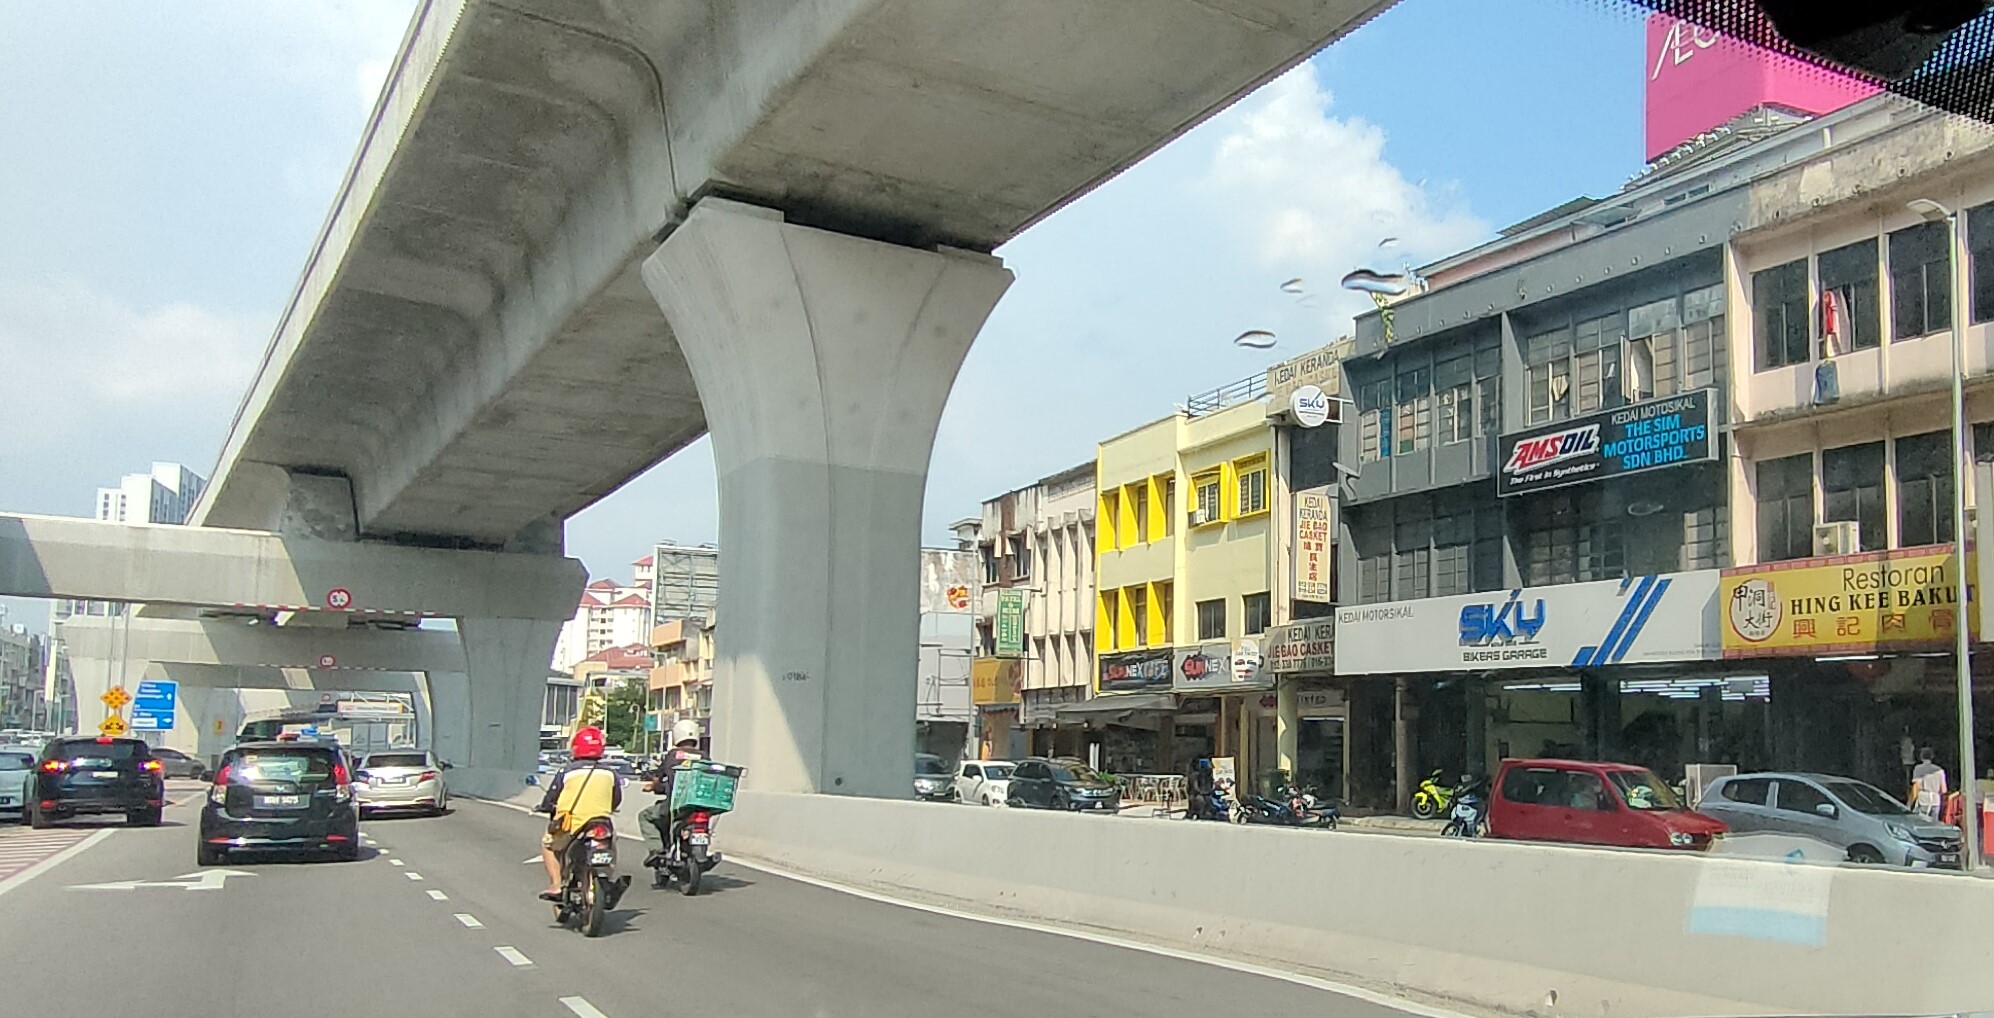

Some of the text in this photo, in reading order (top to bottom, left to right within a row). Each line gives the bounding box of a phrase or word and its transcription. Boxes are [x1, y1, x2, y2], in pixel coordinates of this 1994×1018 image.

[1611, 397, 1695, 425] KEDAI MOTOSIKAL
[1626, 414, 1680, 438] THE SIM
[1506, 424, 1599, 471] AMSOIL
[1604, 425, 1704, 458] MOTORSPORTS
[1623, 451, 1650, 469] SDN
[1525, 472, 1542, 483] First
[1304, 496, 1323, 510] KEDAI
[1299, 530, 1328, 542] CASKET
[1843, 565, 1944, 592] Restoran
[1791, 595, 1841, 615] HING
[1849, 592, 1890, 611] KEE
[1338, 606, 1414, 624] KEDAI MOTORSIKAL
[1458, 589, 1547, 646] SKY
[1288, 626, 1311, 642] KEDAI
[1268, 644, 1280, 658] JIE
[1281, 643, 1298, 657] BAO
[1463, 648, 1547, 662] BIKERS GARAGE
